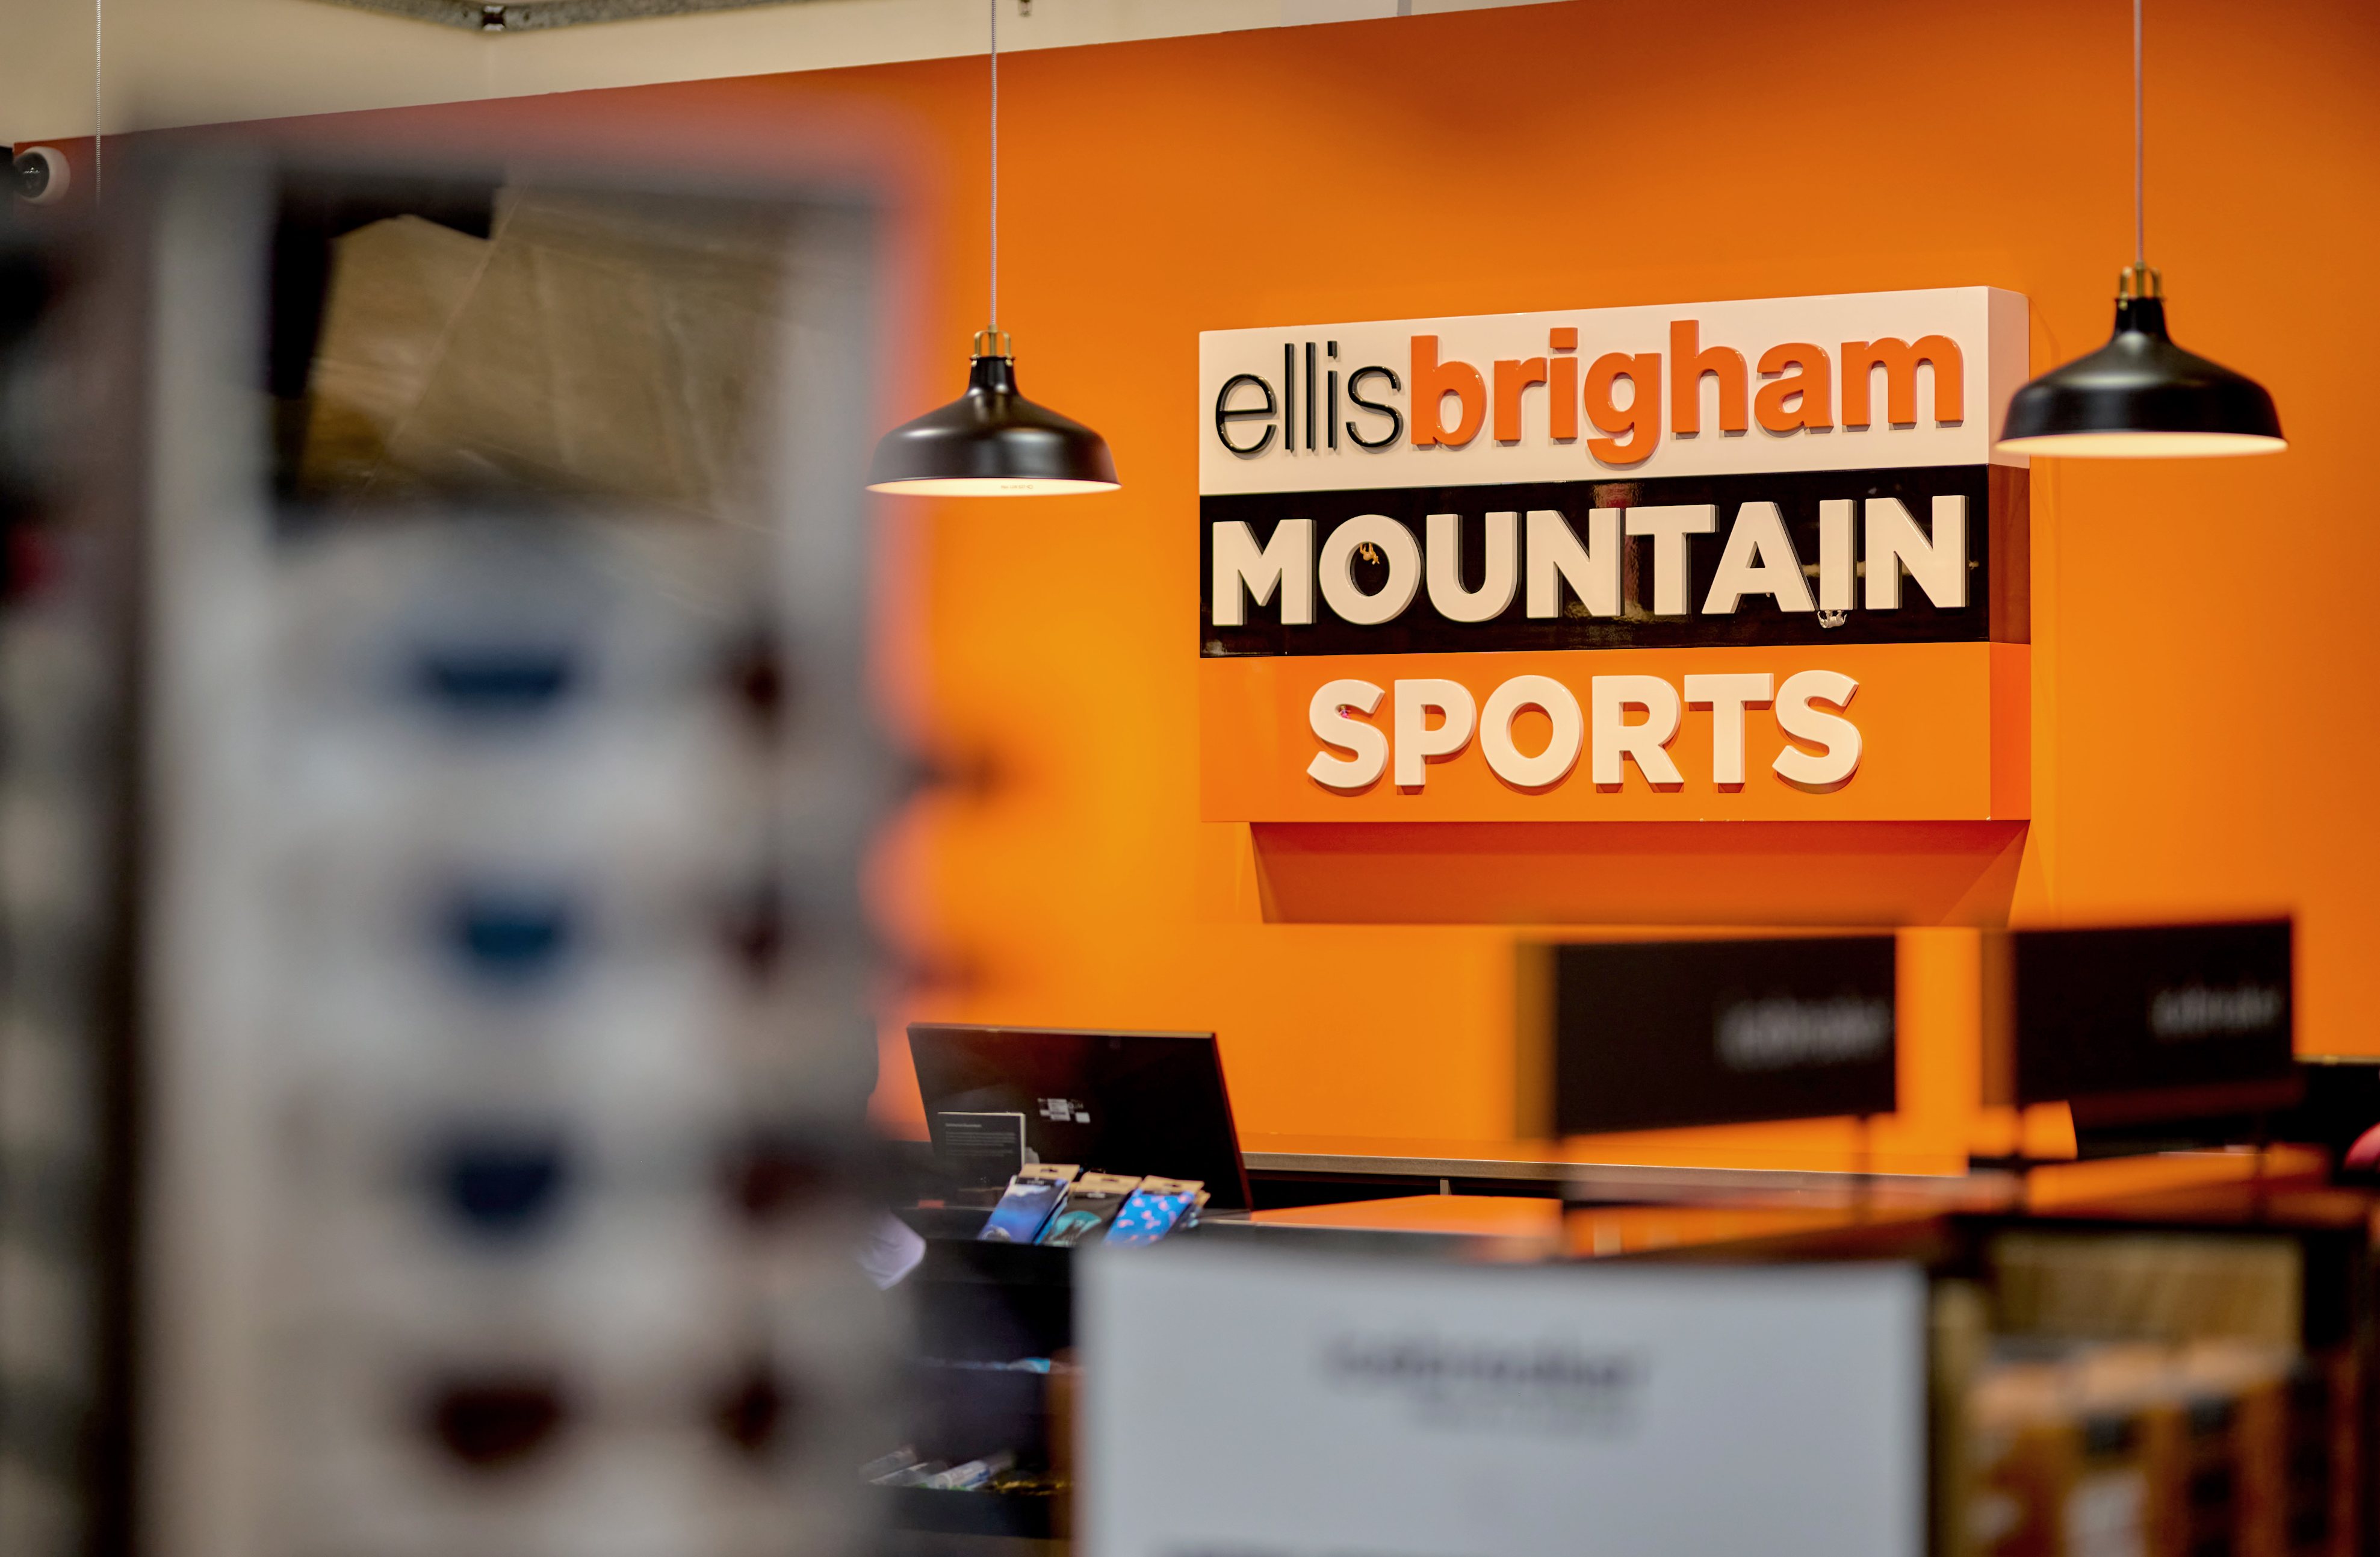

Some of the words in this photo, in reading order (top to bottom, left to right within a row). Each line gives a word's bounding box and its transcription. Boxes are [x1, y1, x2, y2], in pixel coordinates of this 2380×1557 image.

[1215, 319, 1965, 464] ellisbrigham
[1211, 494, 1969, 626] MOUNTAIN
[1306, 670, 1863, 790] SPORTS
